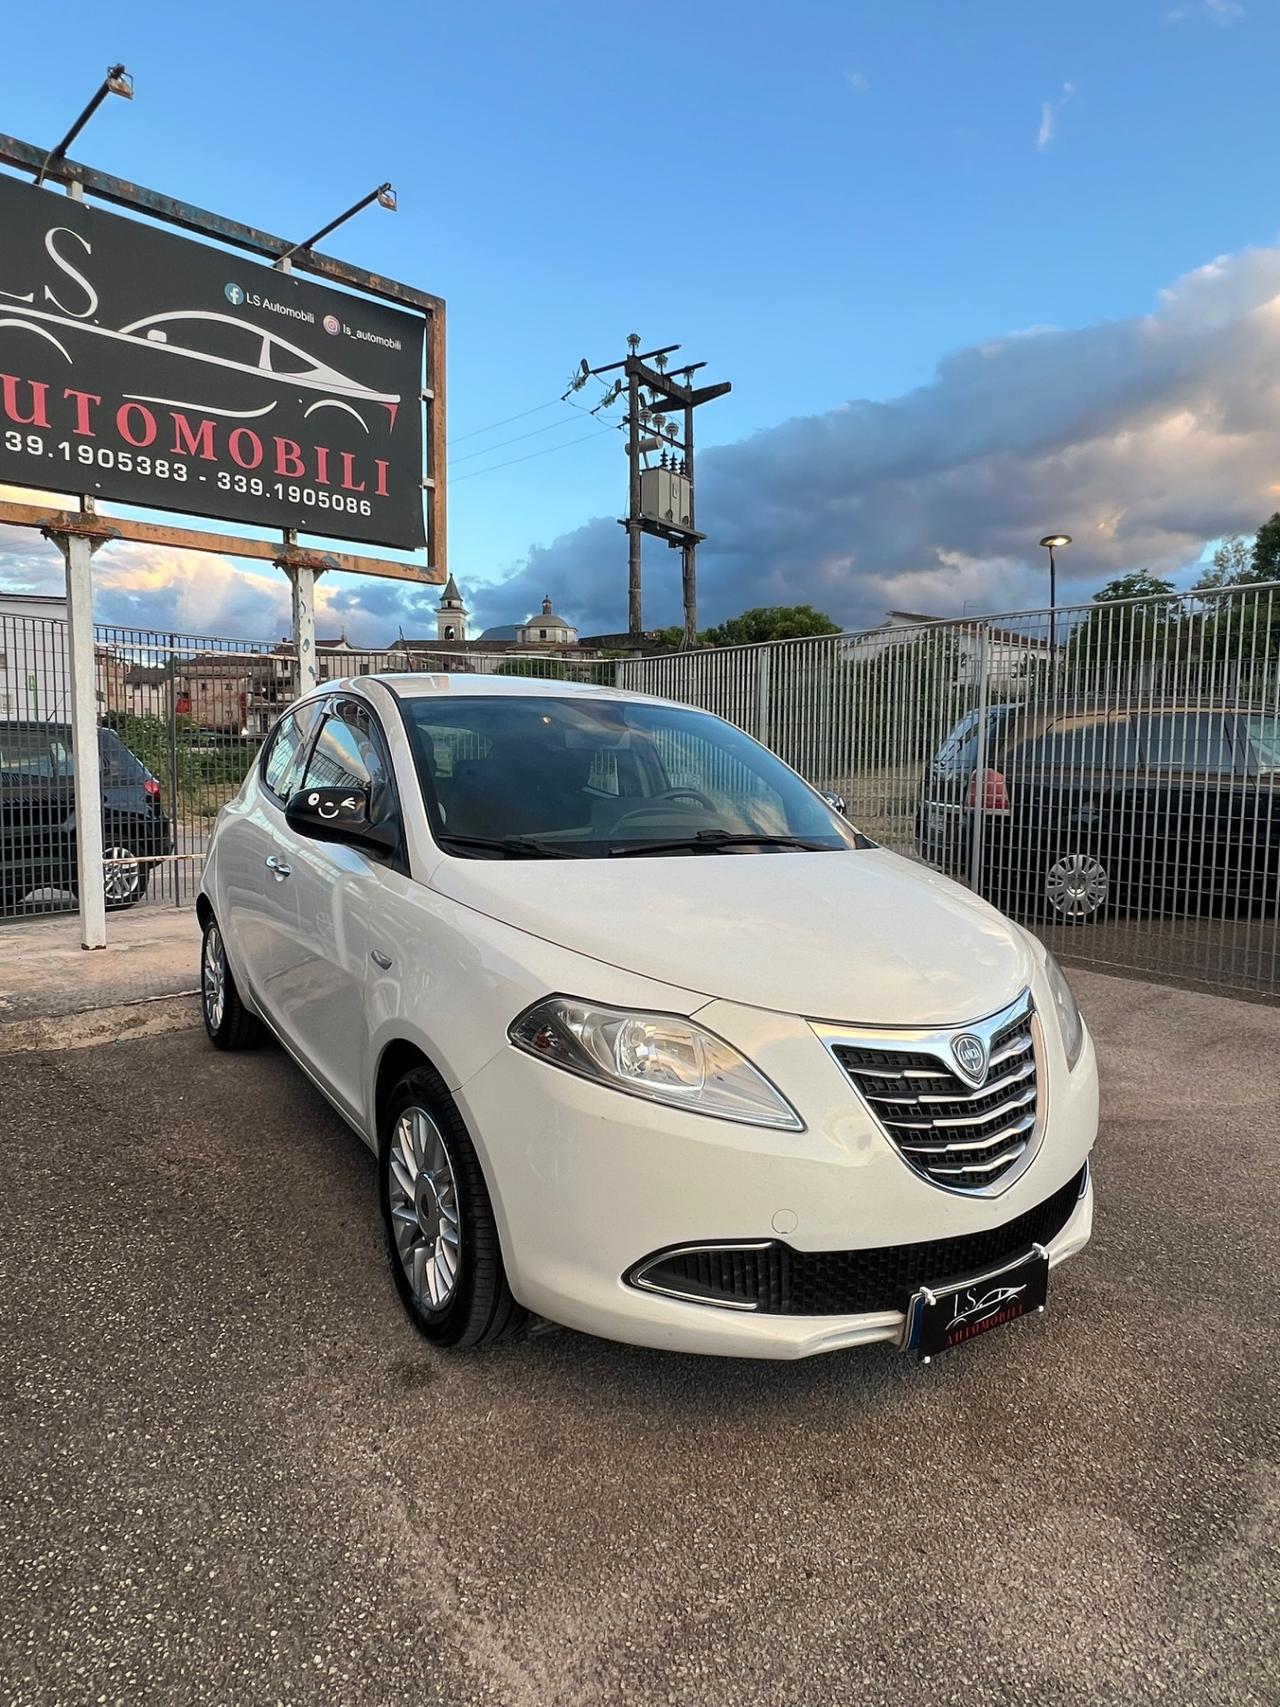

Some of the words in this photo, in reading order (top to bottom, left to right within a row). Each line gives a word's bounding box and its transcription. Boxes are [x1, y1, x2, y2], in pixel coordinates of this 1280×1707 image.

[0, 227, 98, 318] S
[246, 292, 261, 307] LS
[263, 299, 315, 325] Automobili
[217, 471, 372, 516] 339.1905086
[944, 1303, 1024, 1348] AUTOMOBILI
